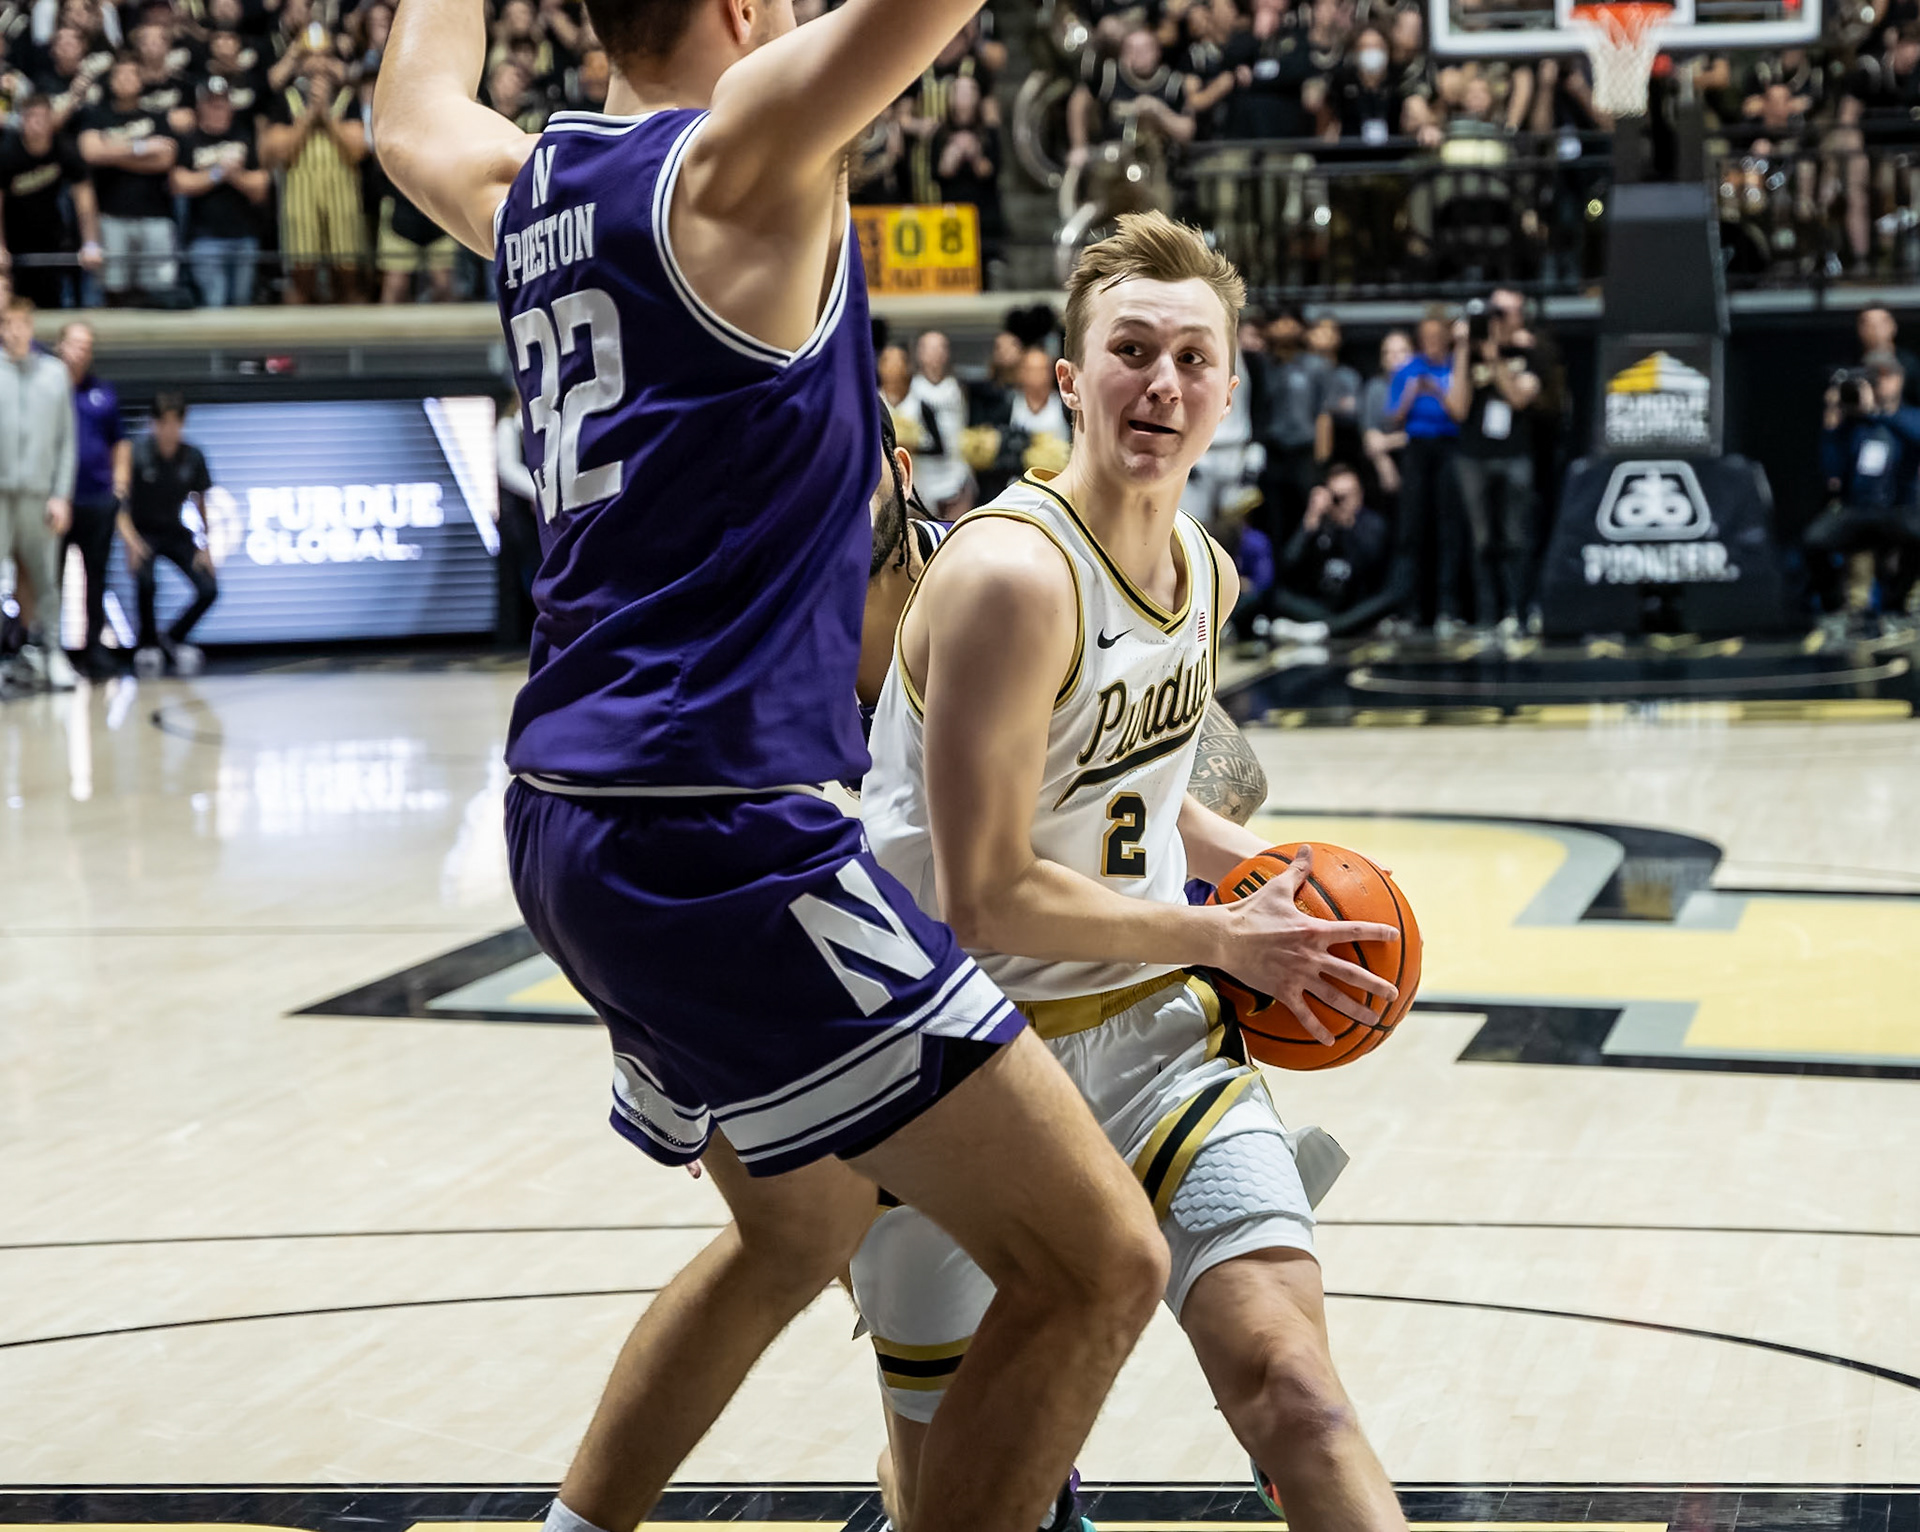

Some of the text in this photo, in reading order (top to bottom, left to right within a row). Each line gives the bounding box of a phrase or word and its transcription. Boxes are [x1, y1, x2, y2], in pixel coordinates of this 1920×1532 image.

[531, 144, 557, 210] N
[504, 202, 598, 290] PRESTON
[510, 288, 625, 525] 32
[247, 482, 444, 530] PURDUE
[1076, 650, 1208, 767] Purdue
[1100, 791, 1148, 879] 2
[788, 858, 936, 1018] N
